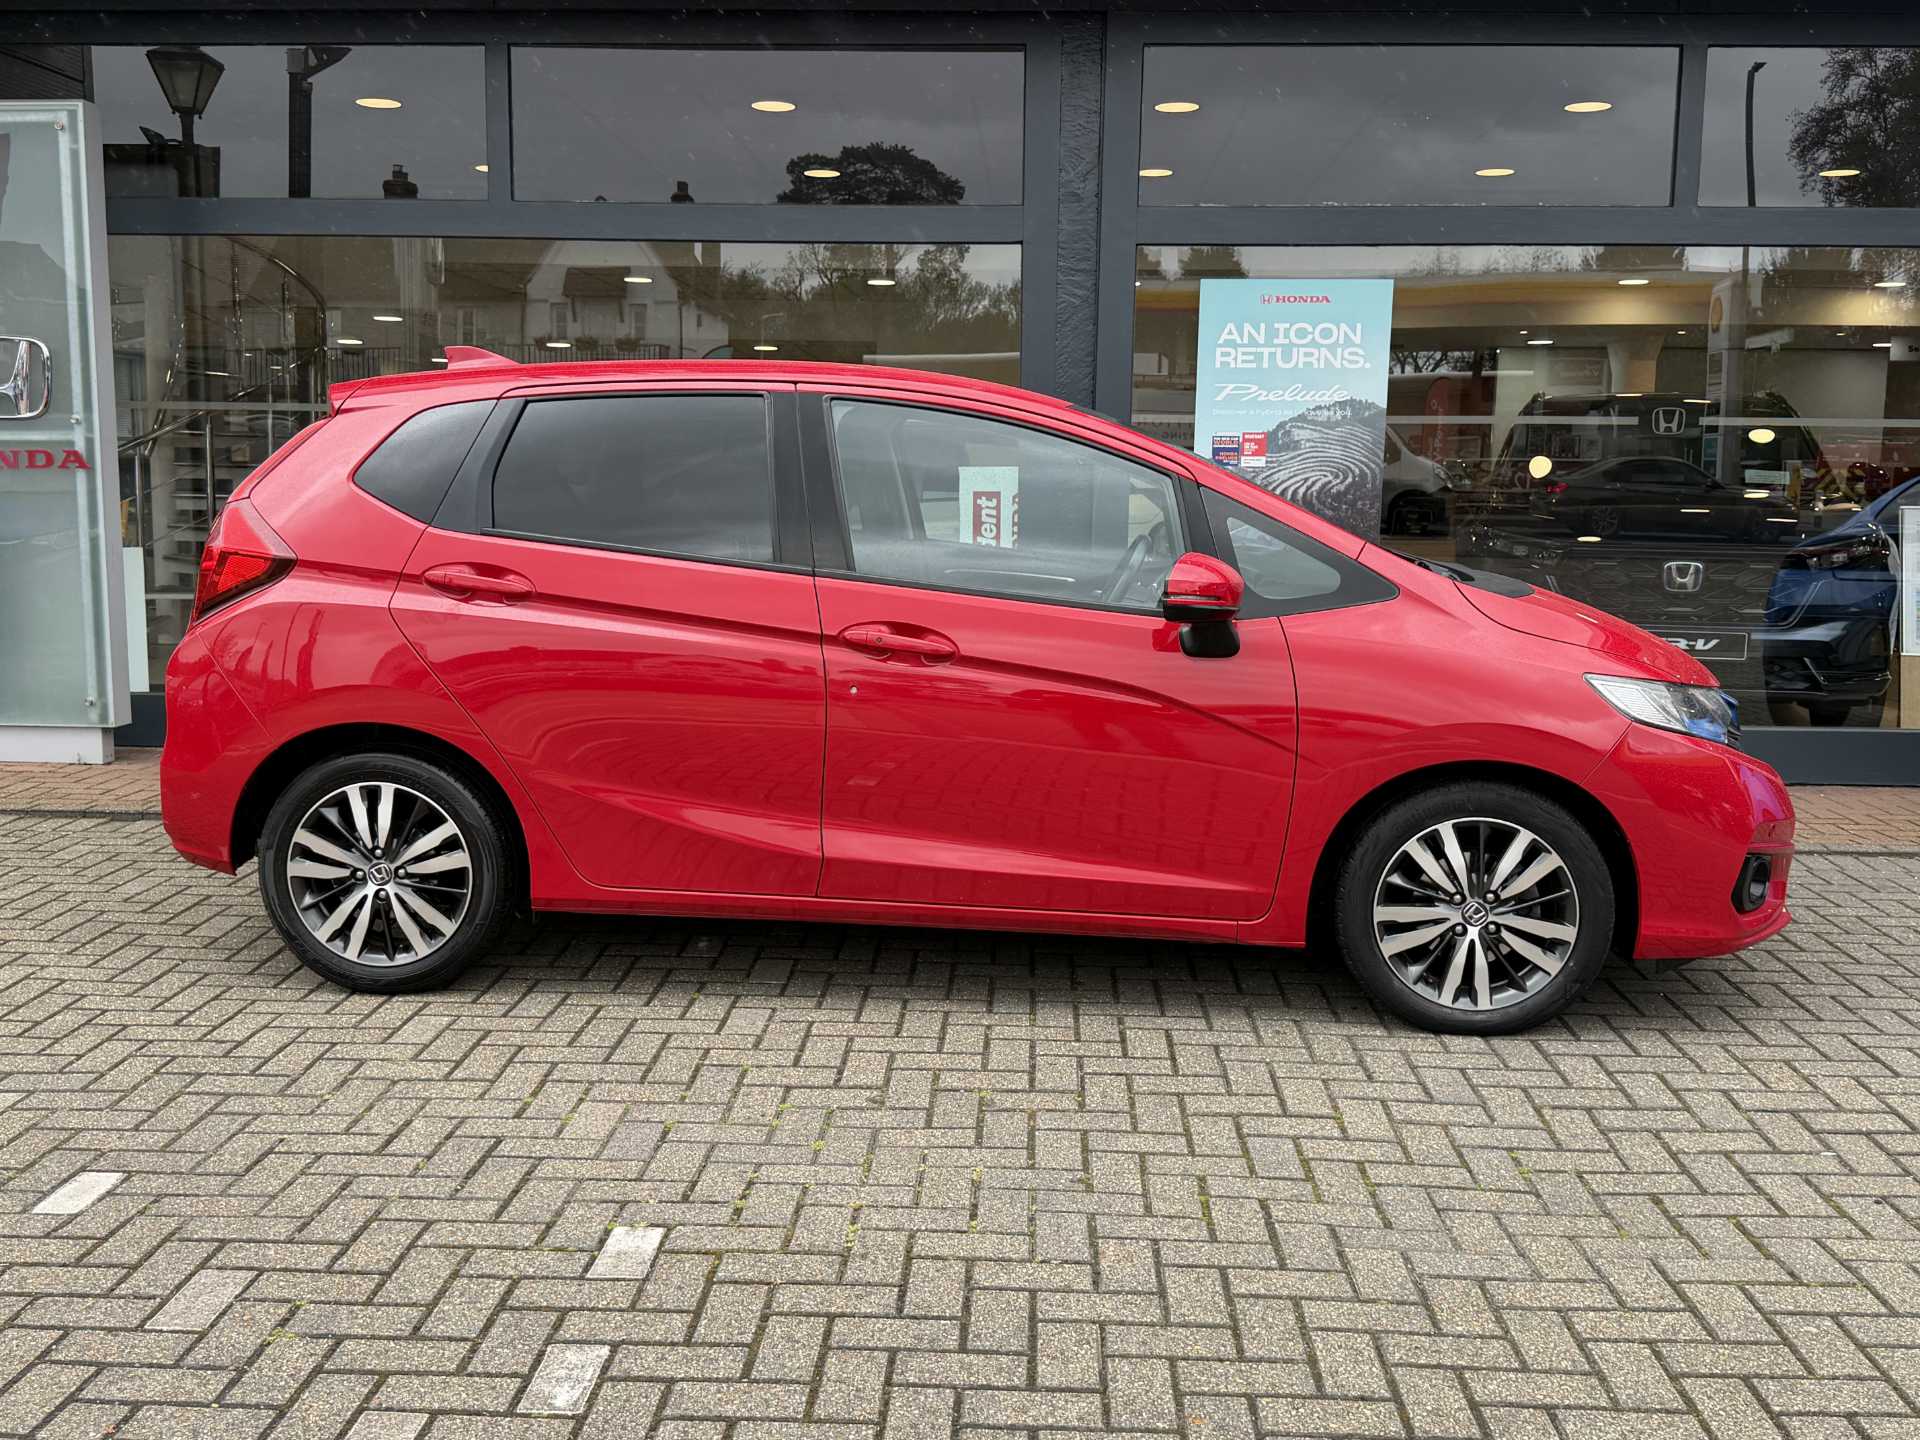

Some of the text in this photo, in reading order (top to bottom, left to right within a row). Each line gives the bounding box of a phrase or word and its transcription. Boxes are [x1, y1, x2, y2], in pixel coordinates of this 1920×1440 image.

[1275, 295, 1332, 304] HONDA
[1216, 322, 1362, 345] AN ICON
[1214, 347, 1372, 369] RETURNS.
[1213, 383, 1352, 402] Prelude
